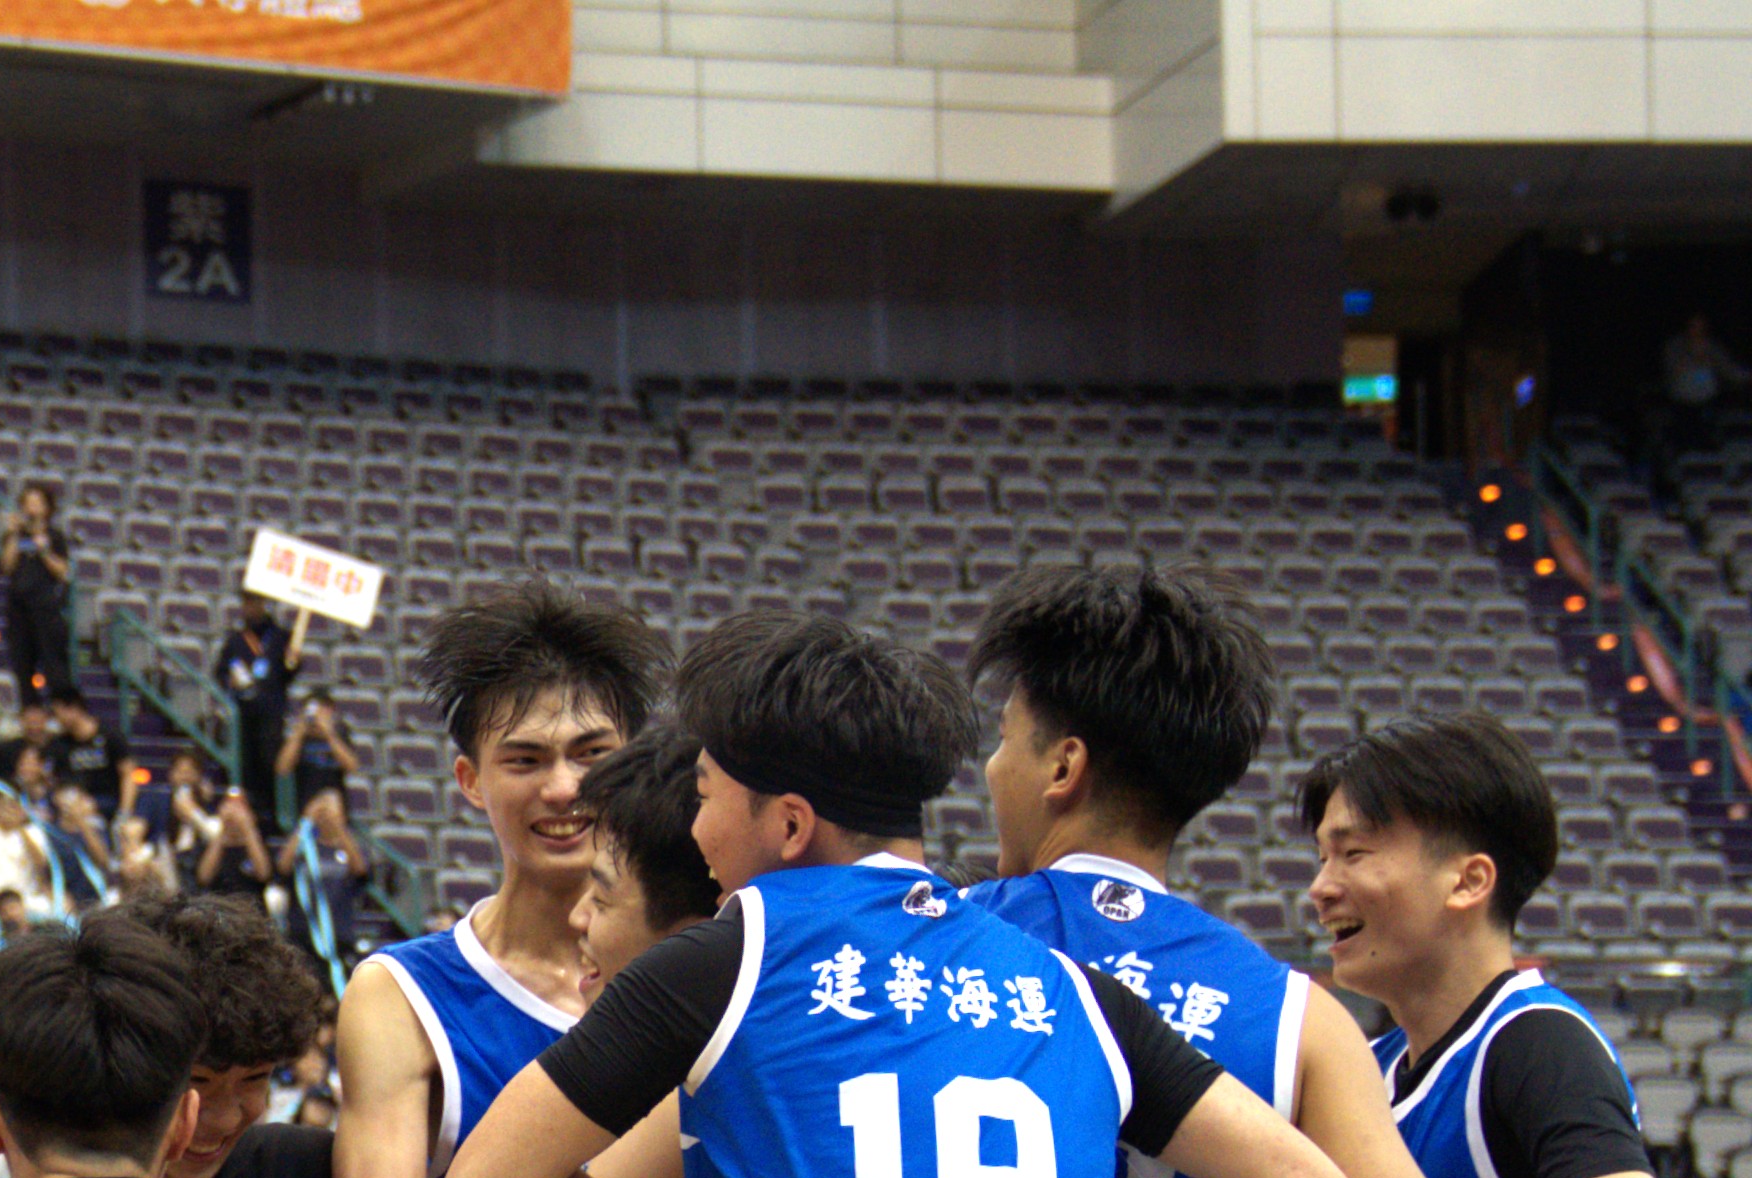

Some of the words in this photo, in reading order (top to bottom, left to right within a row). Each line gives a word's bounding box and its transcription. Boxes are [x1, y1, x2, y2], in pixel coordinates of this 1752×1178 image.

[157, 248, 239, 294] 2A
[807, 943, 1056, 1036] 建華海運
